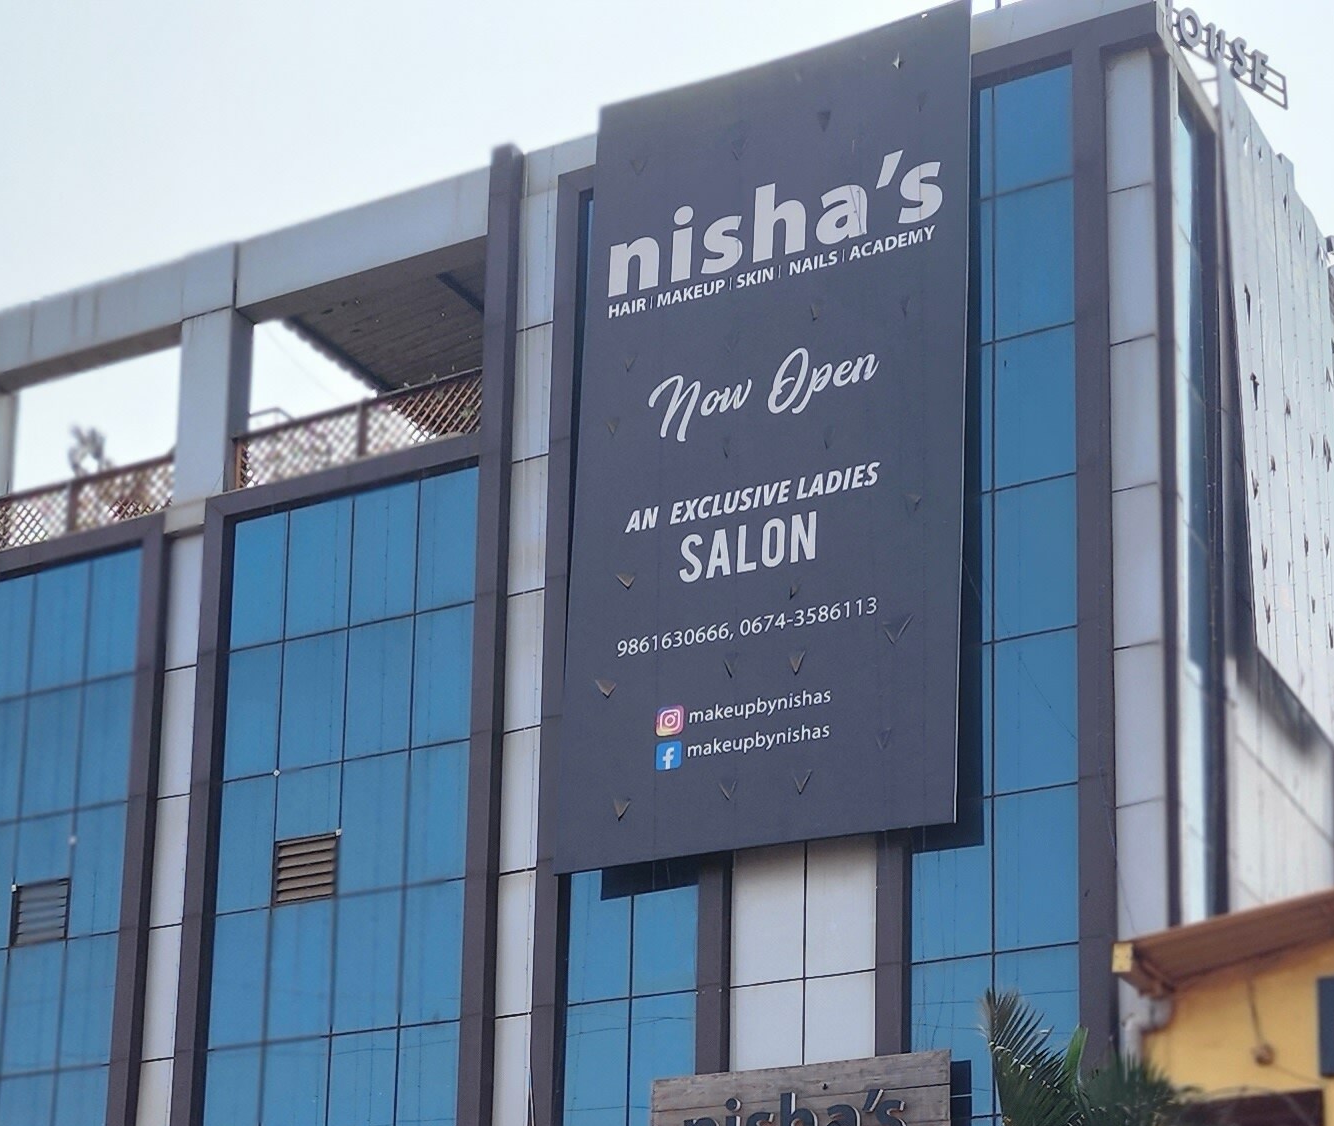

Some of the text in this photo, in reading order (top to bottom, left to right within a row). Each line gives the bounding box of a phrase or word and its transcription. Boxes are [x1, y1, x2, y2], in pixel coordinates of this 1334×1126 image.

[607, 149, 943, 298] nisha's
[608, 225, 936, 319] HAIR MAKEUP SKIN NAILS ACADEMY
[648, 347, 880, 442] Now Open
[625, 461, 881, 533] AN EXCLUSIVE LADIES
[679, 511, 818, 583] SALON
[616, 597, 878, 658] 9861630666, 0674-3586113
[686, 723, 830, 759] makeupbynishas
[688, 688, 832, 725] makeupbynishas
